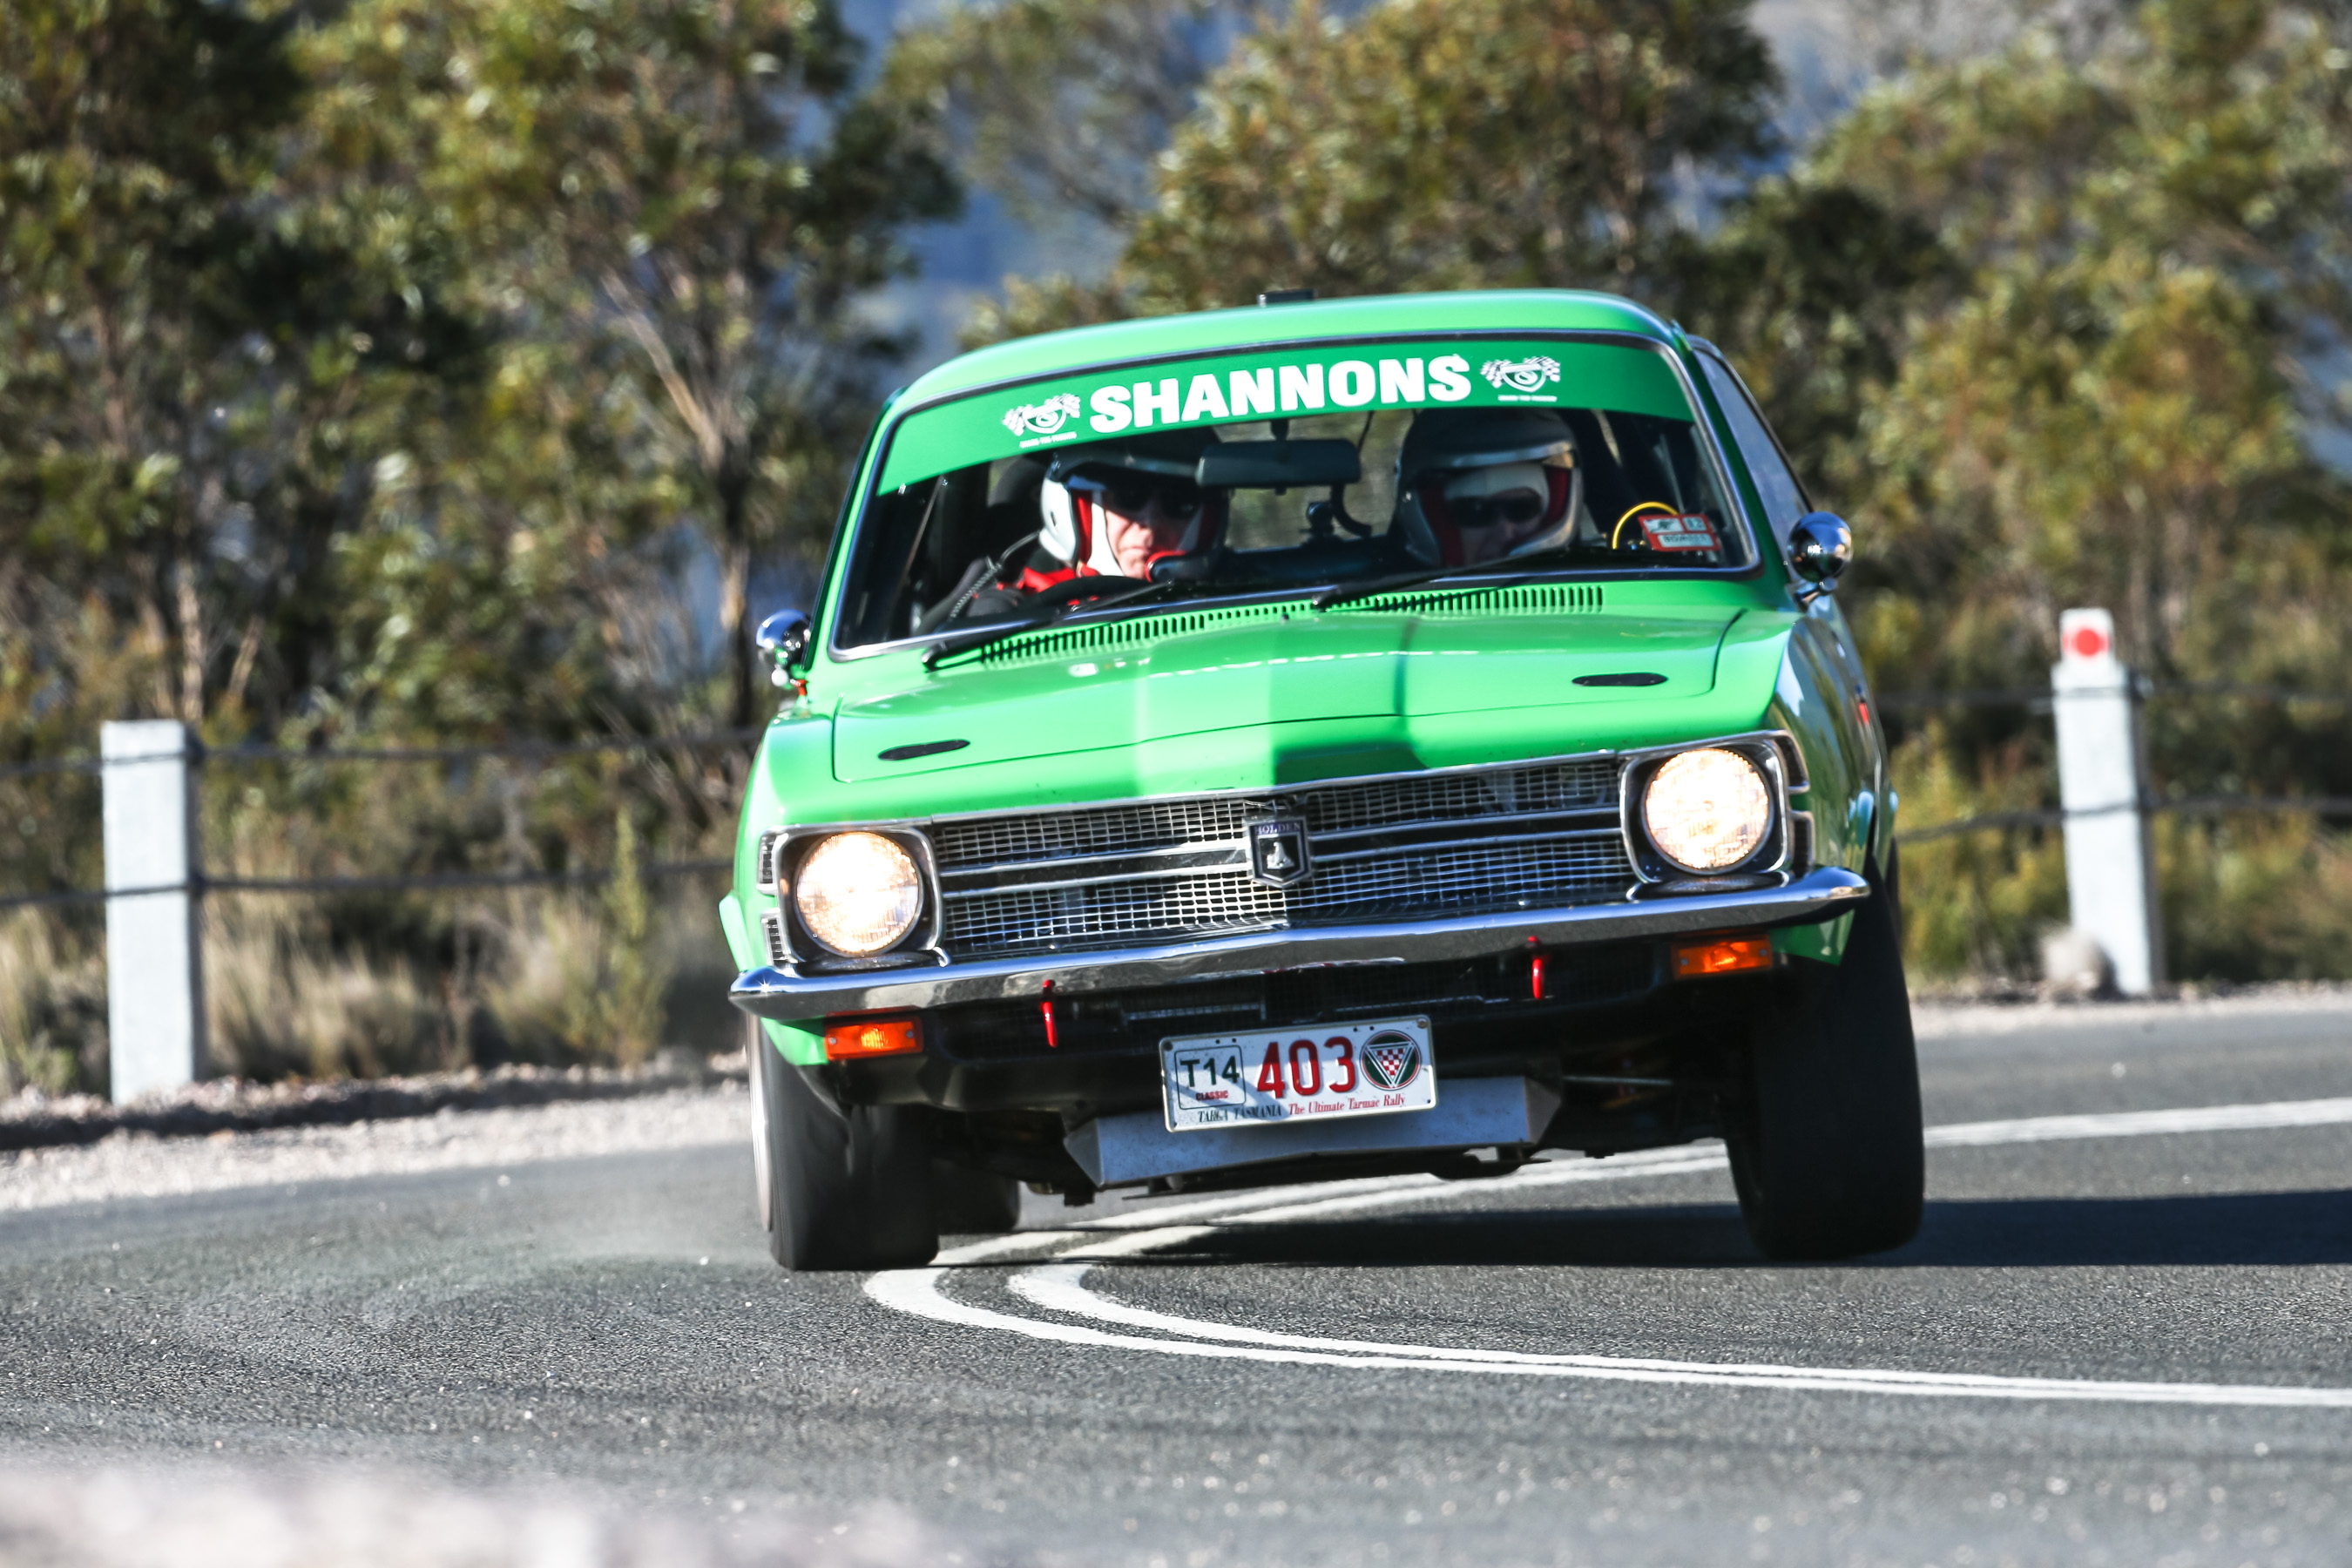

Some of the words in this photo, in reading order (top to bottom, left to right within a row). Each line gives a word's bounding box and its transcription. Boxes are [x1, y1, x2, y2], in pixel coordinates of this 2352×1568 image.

[1090, 354, 1471, 433] SHANNONS
[1254, 822, 1301, 835] HOLDEN
[1179, 1056, 1240, 1087] T14
[1257, 1037, 1356, 1098] 403
[1195, 1091, 1229, 1101] CLASSIC
[1289, 1104, 1305, 1115] The
[1308, 1099, 1345, 1113] Ultimate
[1348, 1097, 1380, 1110] Tarmac
[1383, 1093, 1406, 1108] Rally
[1198, 1109, 1229, 1123] TARGA
[1233, 1105, 1281, 1119] TASMANIA
